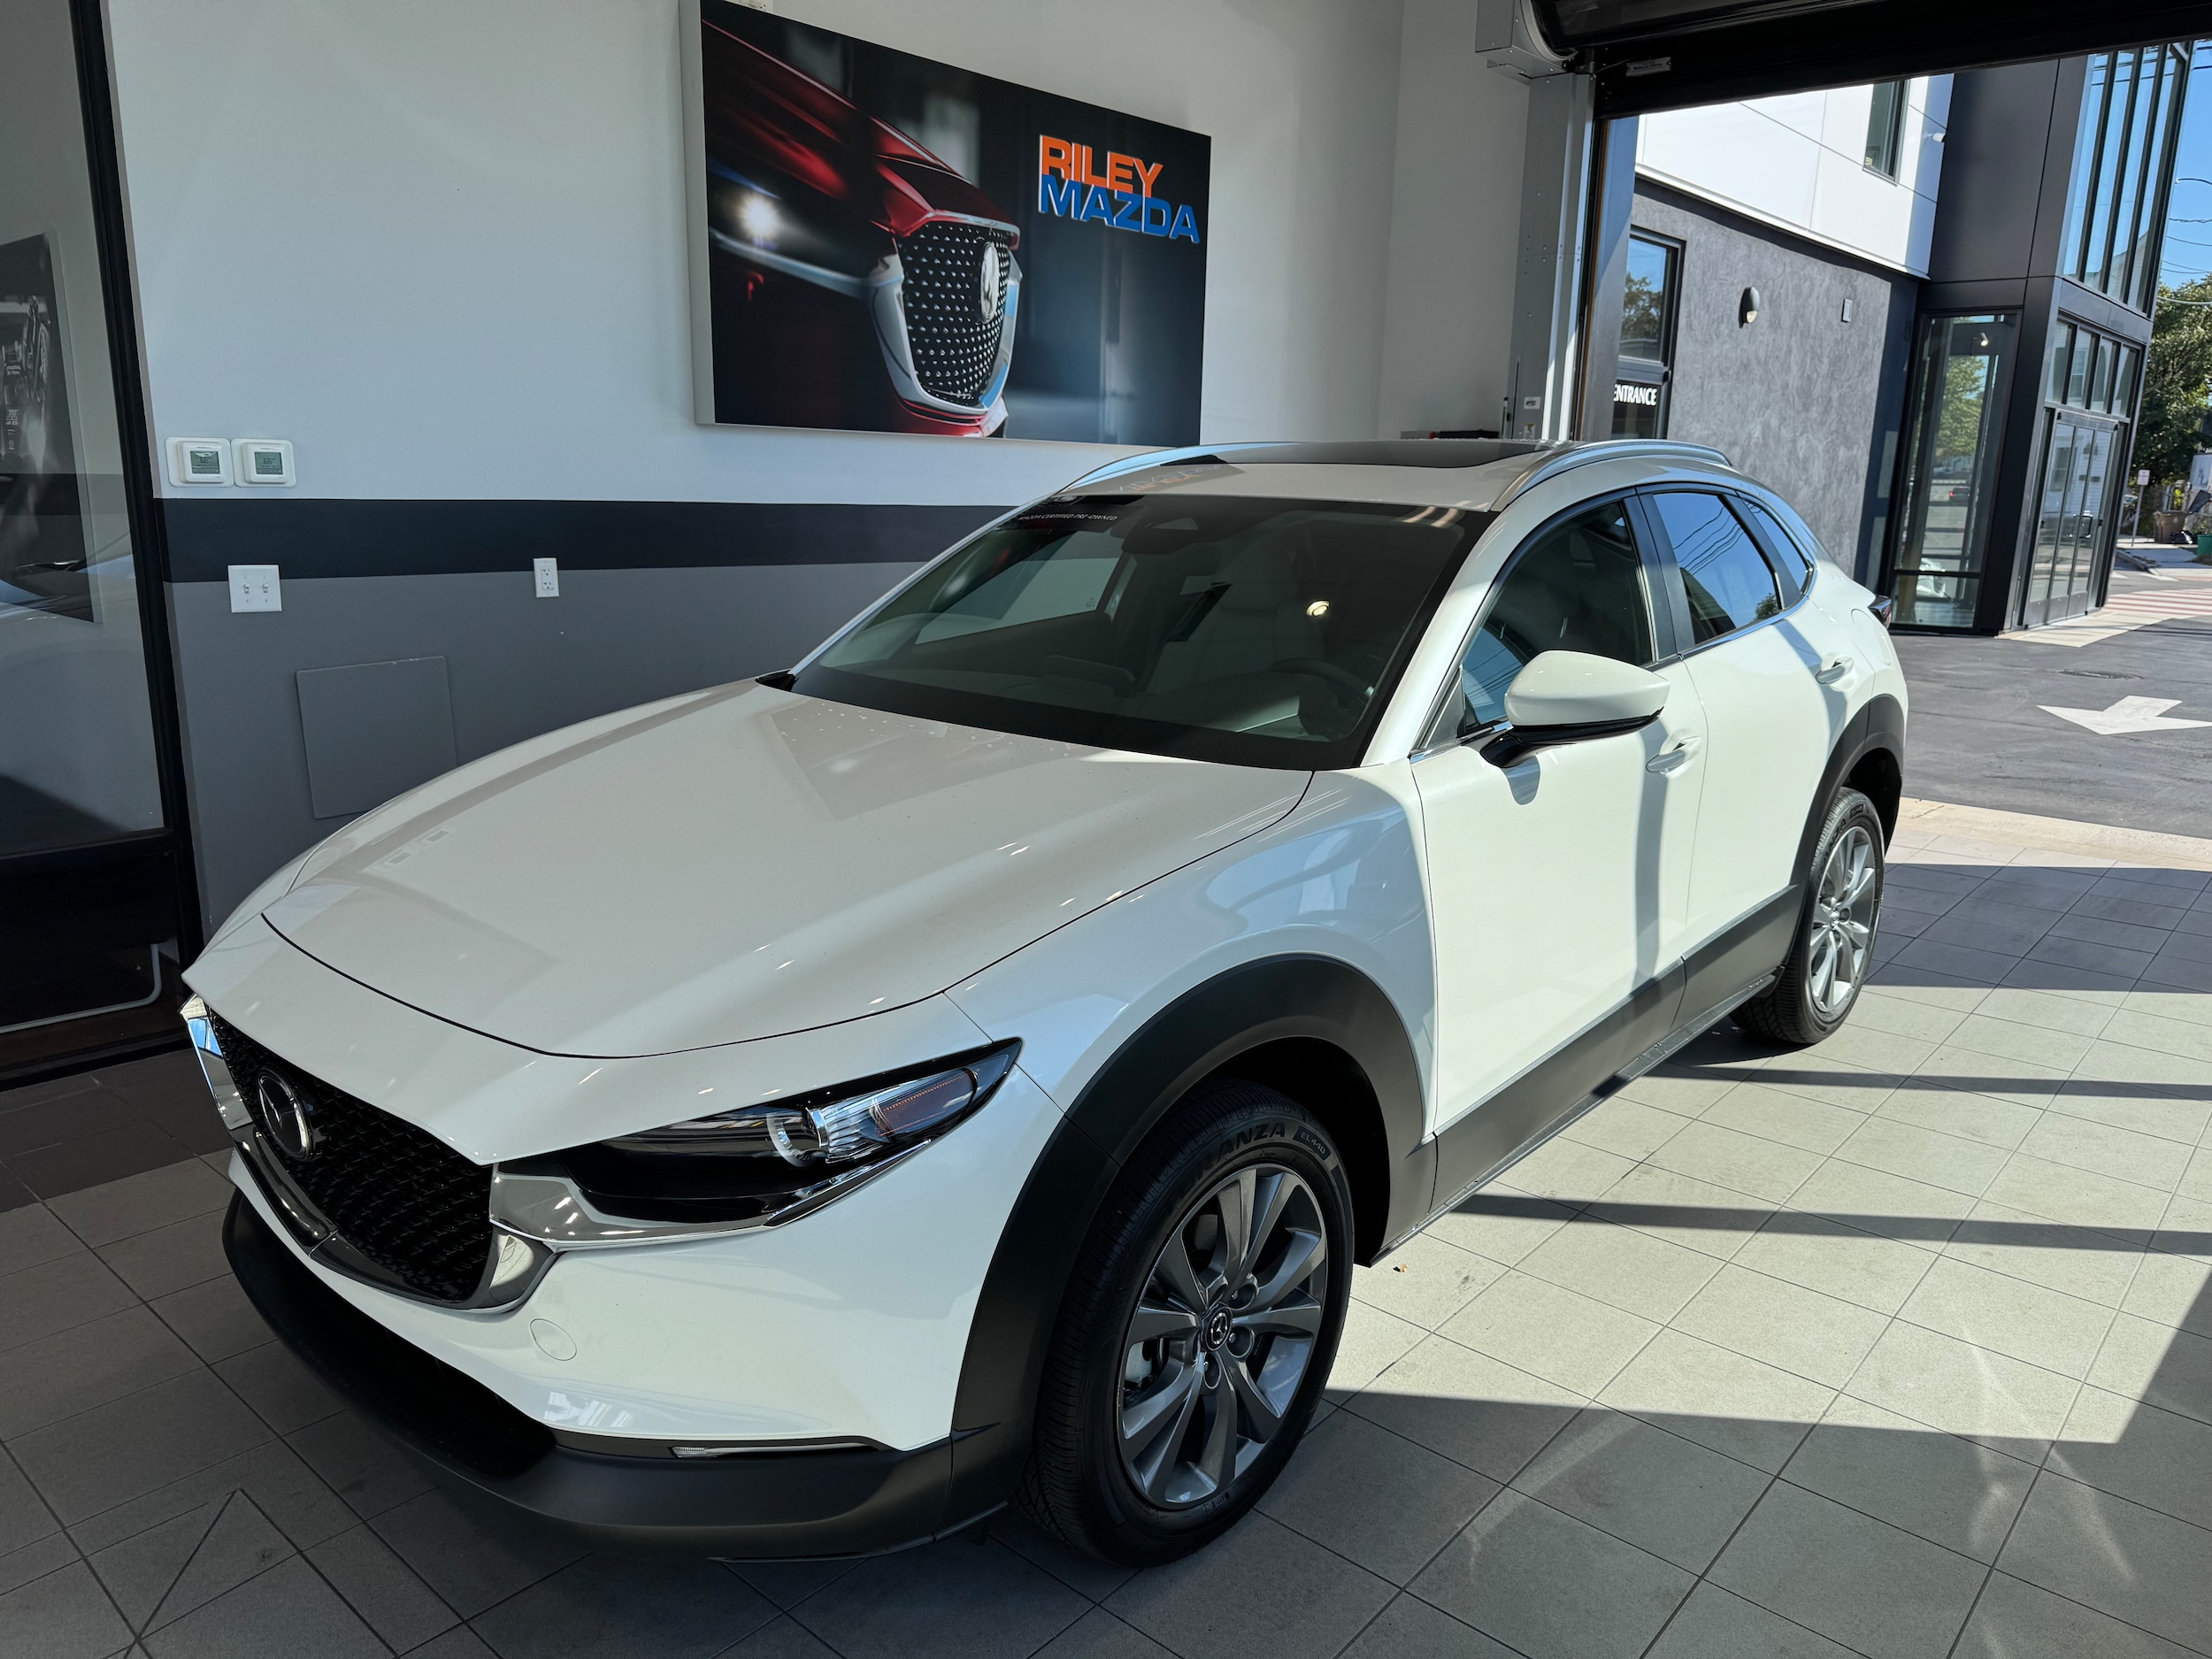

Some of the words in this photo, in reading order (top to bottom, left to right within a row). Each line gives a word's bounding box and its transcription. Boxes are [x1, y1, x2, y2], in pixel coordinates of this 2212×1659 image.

[1040, 134, 1164, 198] RILEY
[1038, 173, 1201, 243] MAZDA
[1301, 1132, 1326, 1155] EL440
